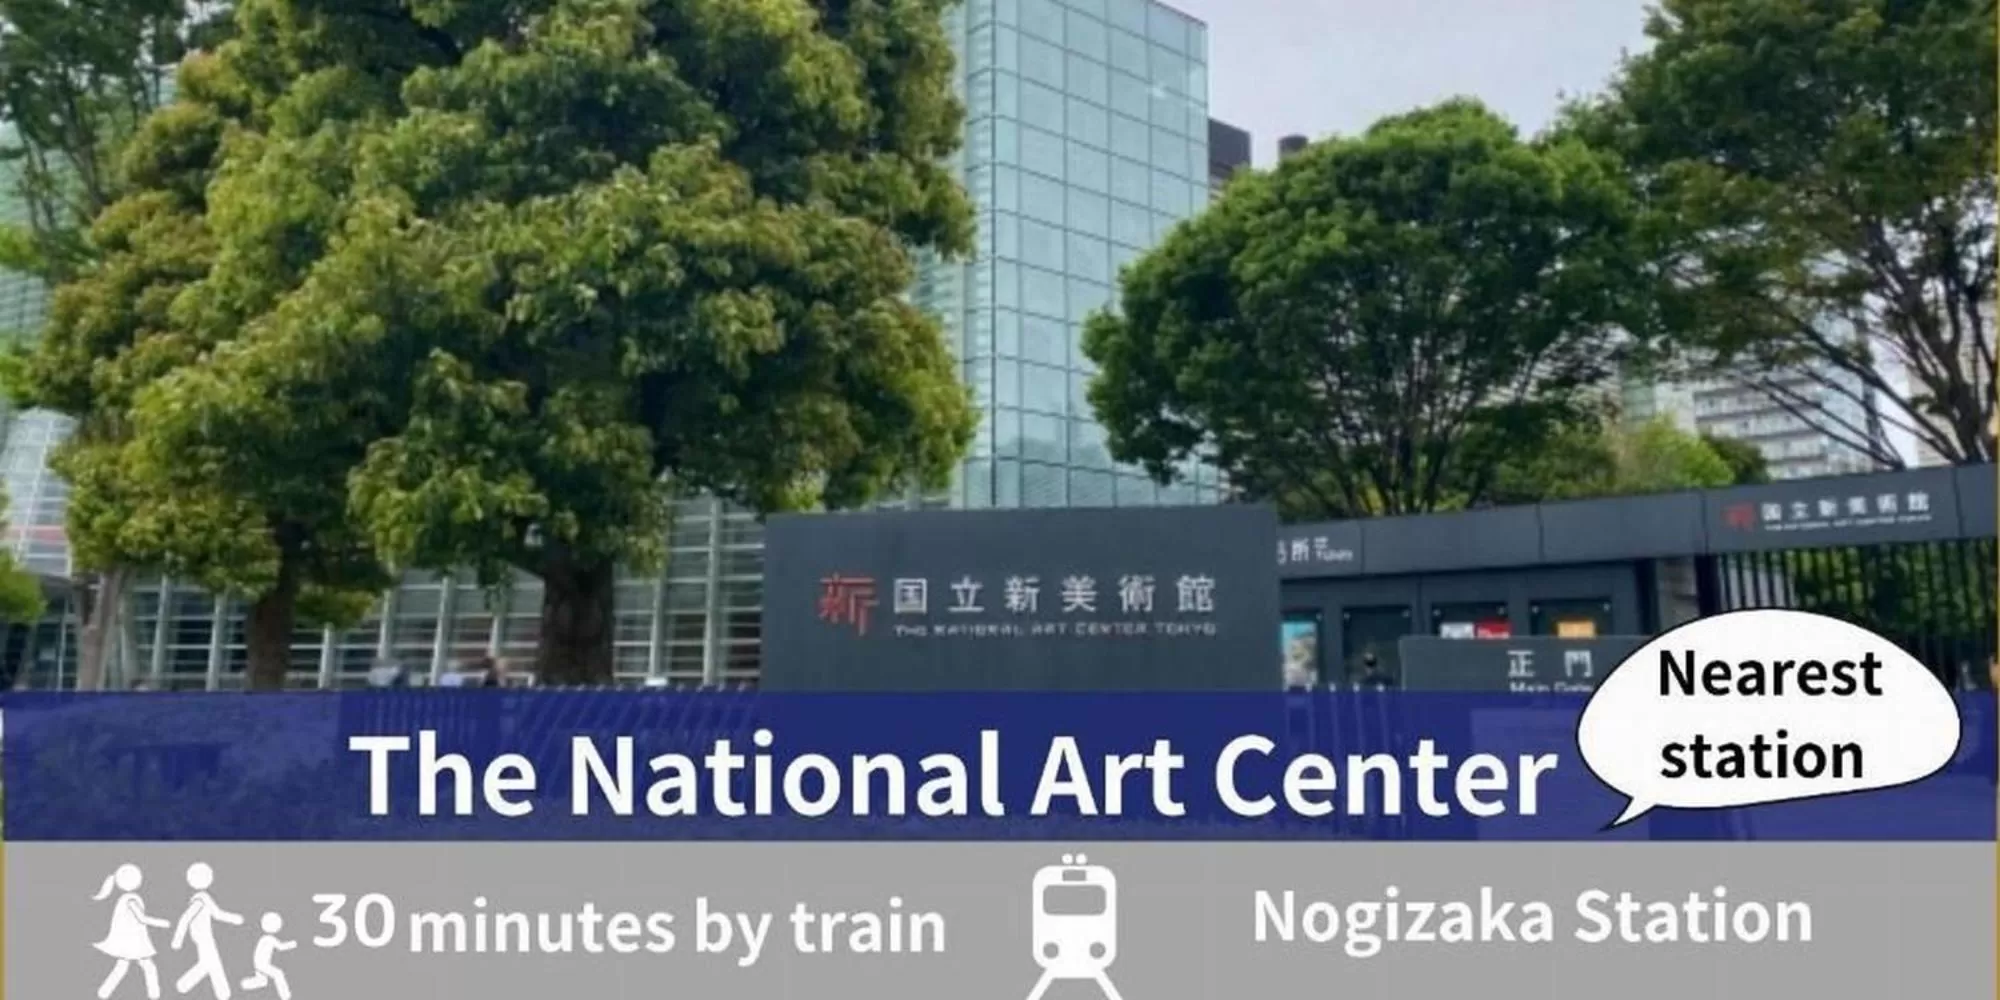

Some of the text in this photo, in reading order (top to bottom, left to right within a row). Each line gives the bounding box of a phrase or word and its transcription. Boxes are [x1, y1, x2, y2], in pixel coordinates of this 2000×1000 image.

[893, 575, 1216, 613] 国立新美術館
[1506, 649, 1593, 678] 正門
